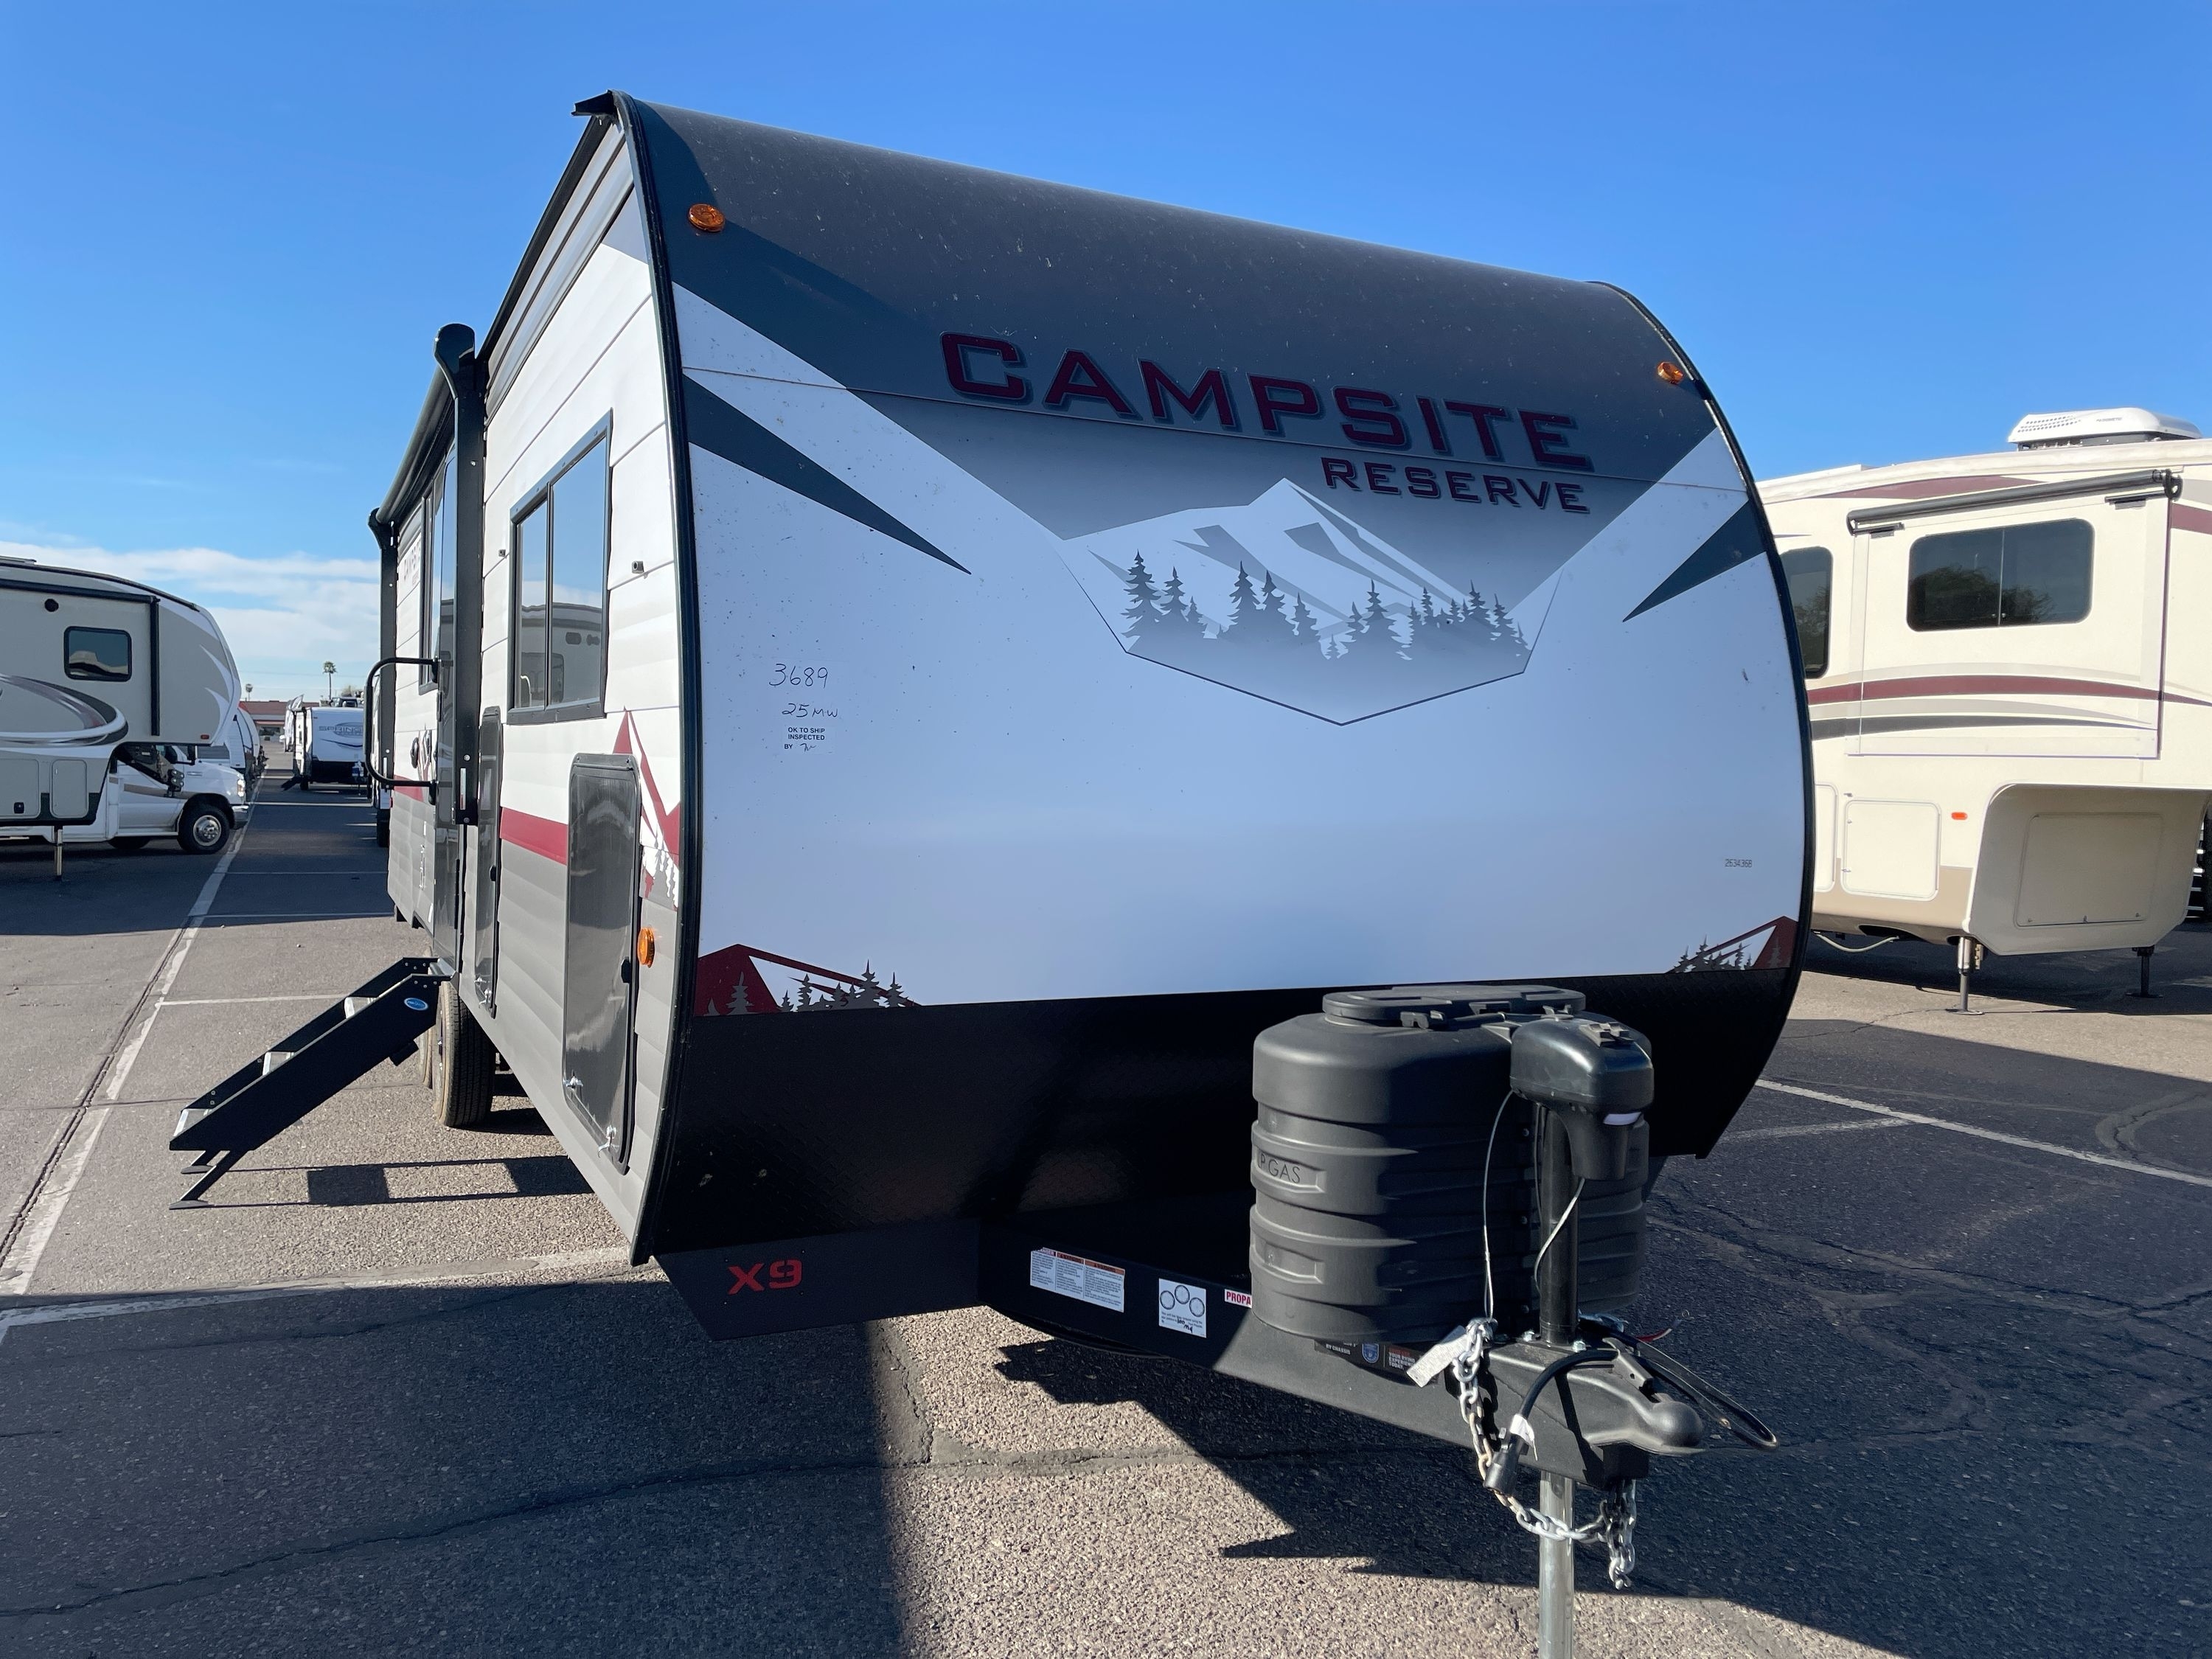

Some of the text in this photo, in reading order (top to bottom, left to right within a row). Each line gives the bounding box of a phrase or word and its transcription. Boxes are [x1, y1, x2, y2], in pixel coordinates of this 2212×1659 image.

[939, 330, 1593, 470] CAMPSITE
[1322, 456, 1590, 514] RESERVE
[769, 663, 829, 689] 3689
[1268, 1158, 1301, 1184] GAS
[727, 1259, 803, 1295] X9
[1226, 1291, 1251, 1305] PROPA
[1388, 1357, 1413, 1366] EXPERIEN
